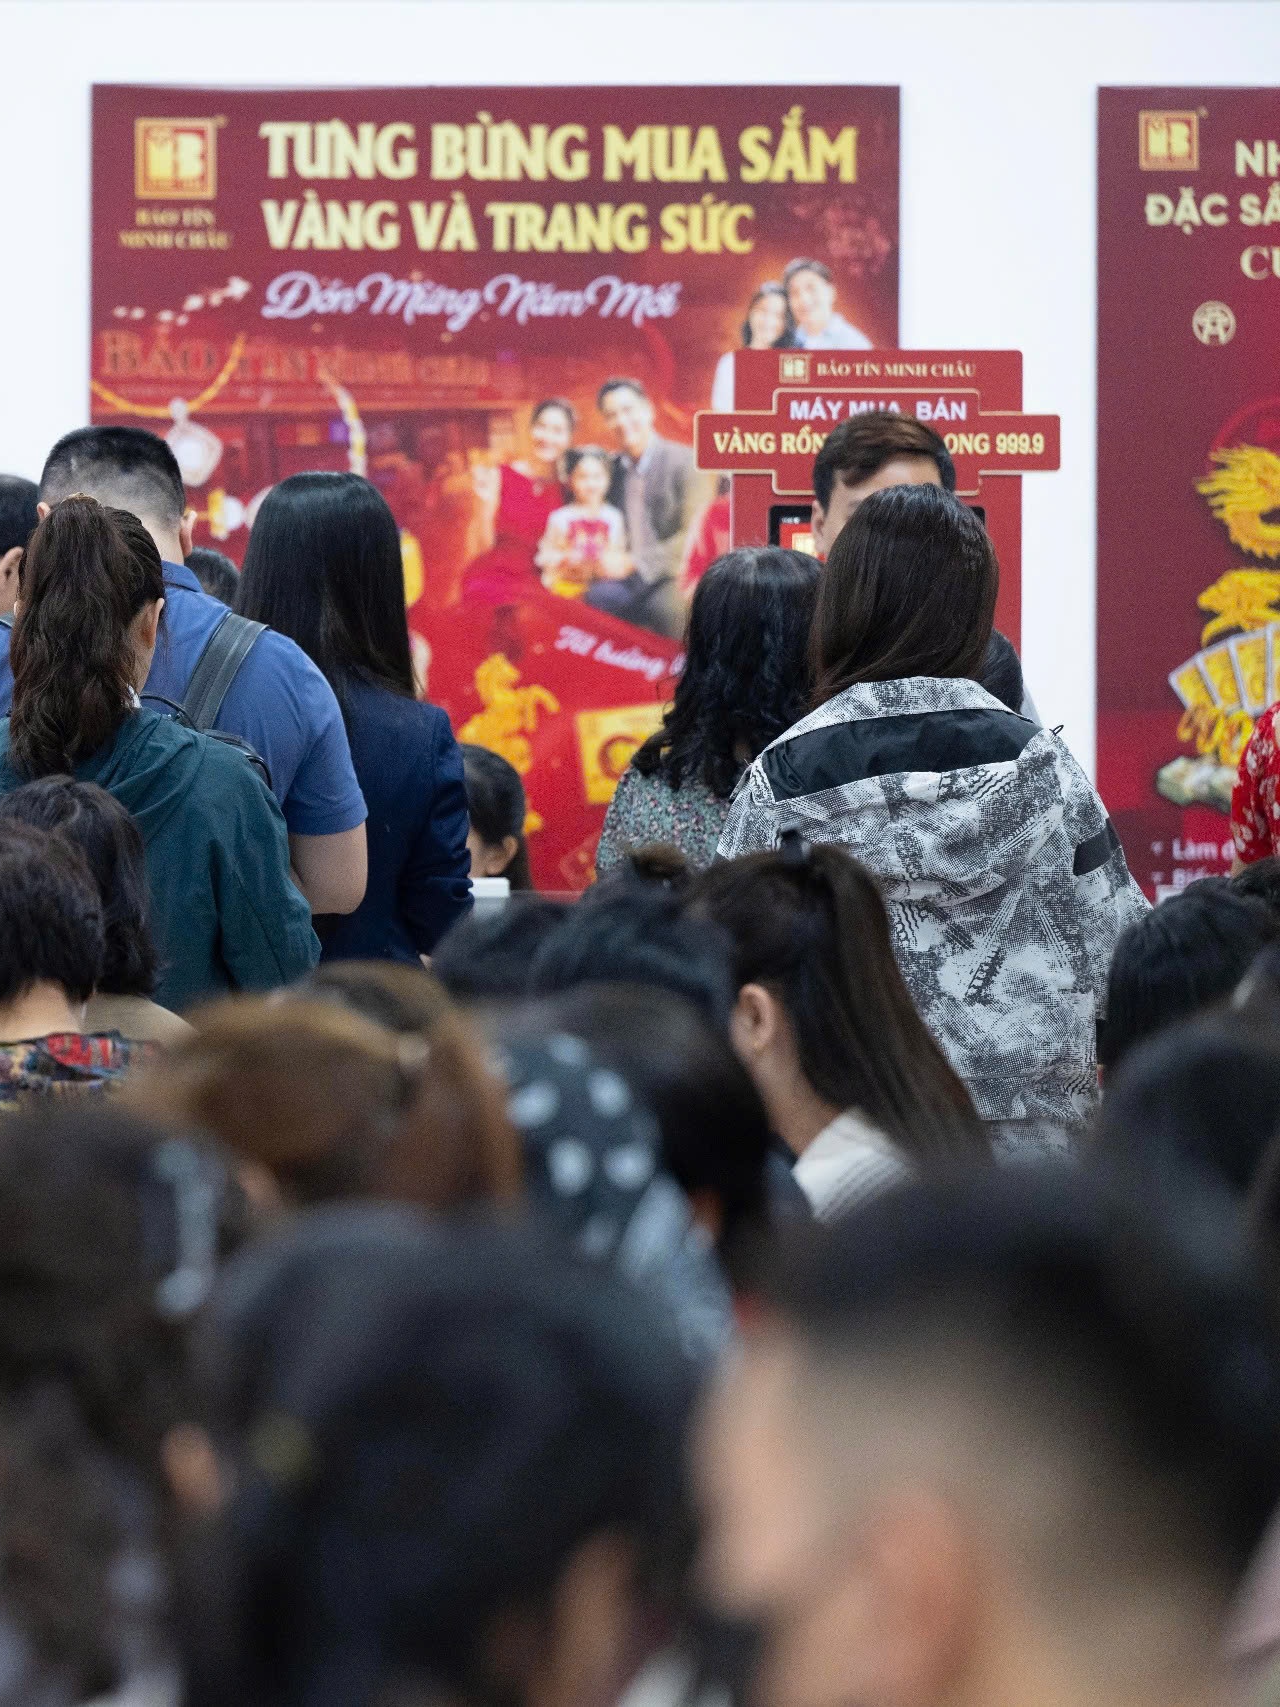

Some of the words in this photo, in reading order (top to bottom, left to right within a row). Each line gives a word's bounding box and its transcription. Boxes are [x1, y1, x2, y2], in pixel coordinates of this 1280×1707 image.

[258, 118, 417, 180] TƯNG
[430, 110, 590, 182] BỪNG
[602, 125, 728, 183] MUA
[737, 105, 860, 184] SẮM
[261, 190, 401, 251] VÀNG
[409, 191, 479, 252] VÀ
[484, 201, 650, 253] TRANG
[659, 193, 756, 254] SỨC
[1144, 186, 1230, 236] ĐẶC
[884, 361, 928, 377] MINH
[915, 396, 967, 421] BÁN
[713, 426, 776, 454] VÀNG
[781, 424, 828, 454] RỒN
[944, 432, 990, 455] ONG
[995, 432, 1044, 455] 999.9
